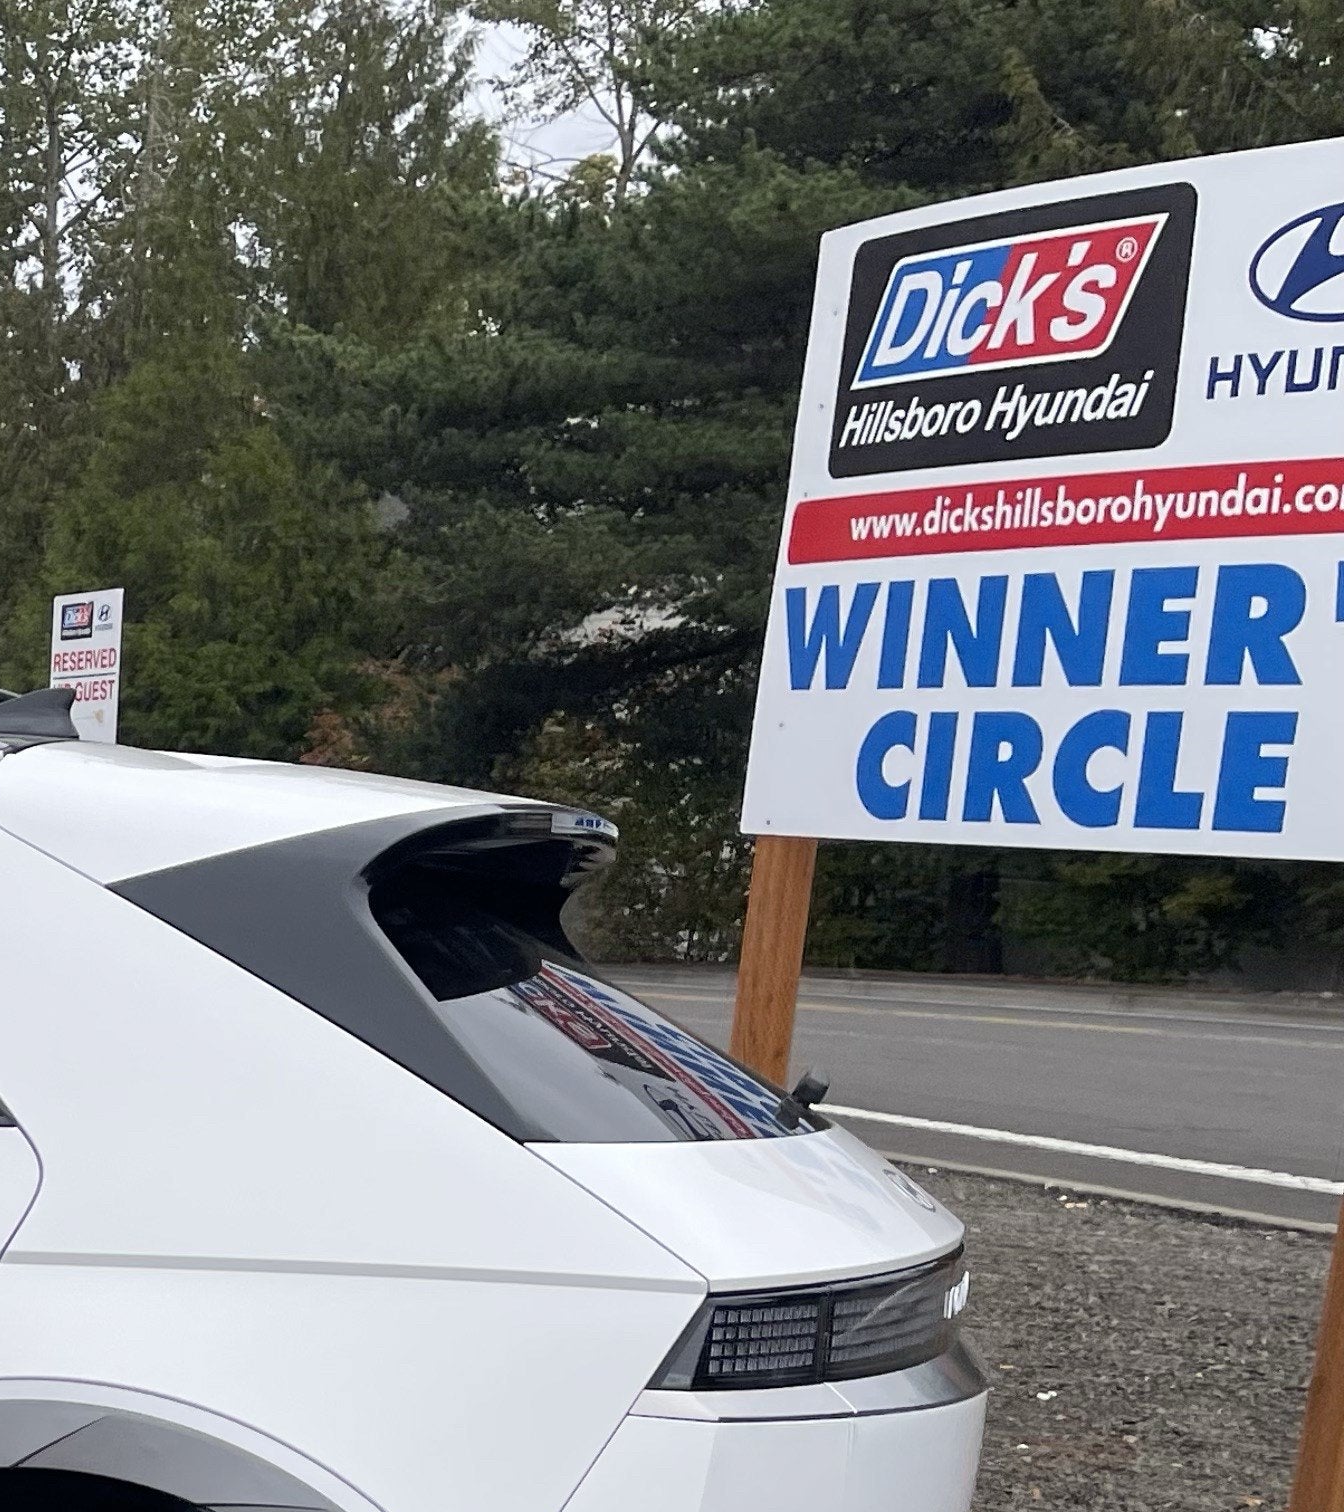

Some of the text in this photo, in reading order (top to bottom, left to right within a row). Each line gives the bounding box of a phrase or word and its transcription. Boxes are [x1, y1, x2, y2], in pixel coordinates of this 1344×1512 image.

[838, 369, 1155, 449] Hillsboro Hyundai
[849, 471, 1344, 541] www.dickshillsborohyundai.co
[53, 647, 118, 672] RESERVED
[74, 679, 116, 702] GUEST
[856, 709, 1299, 833] CIRCLE
